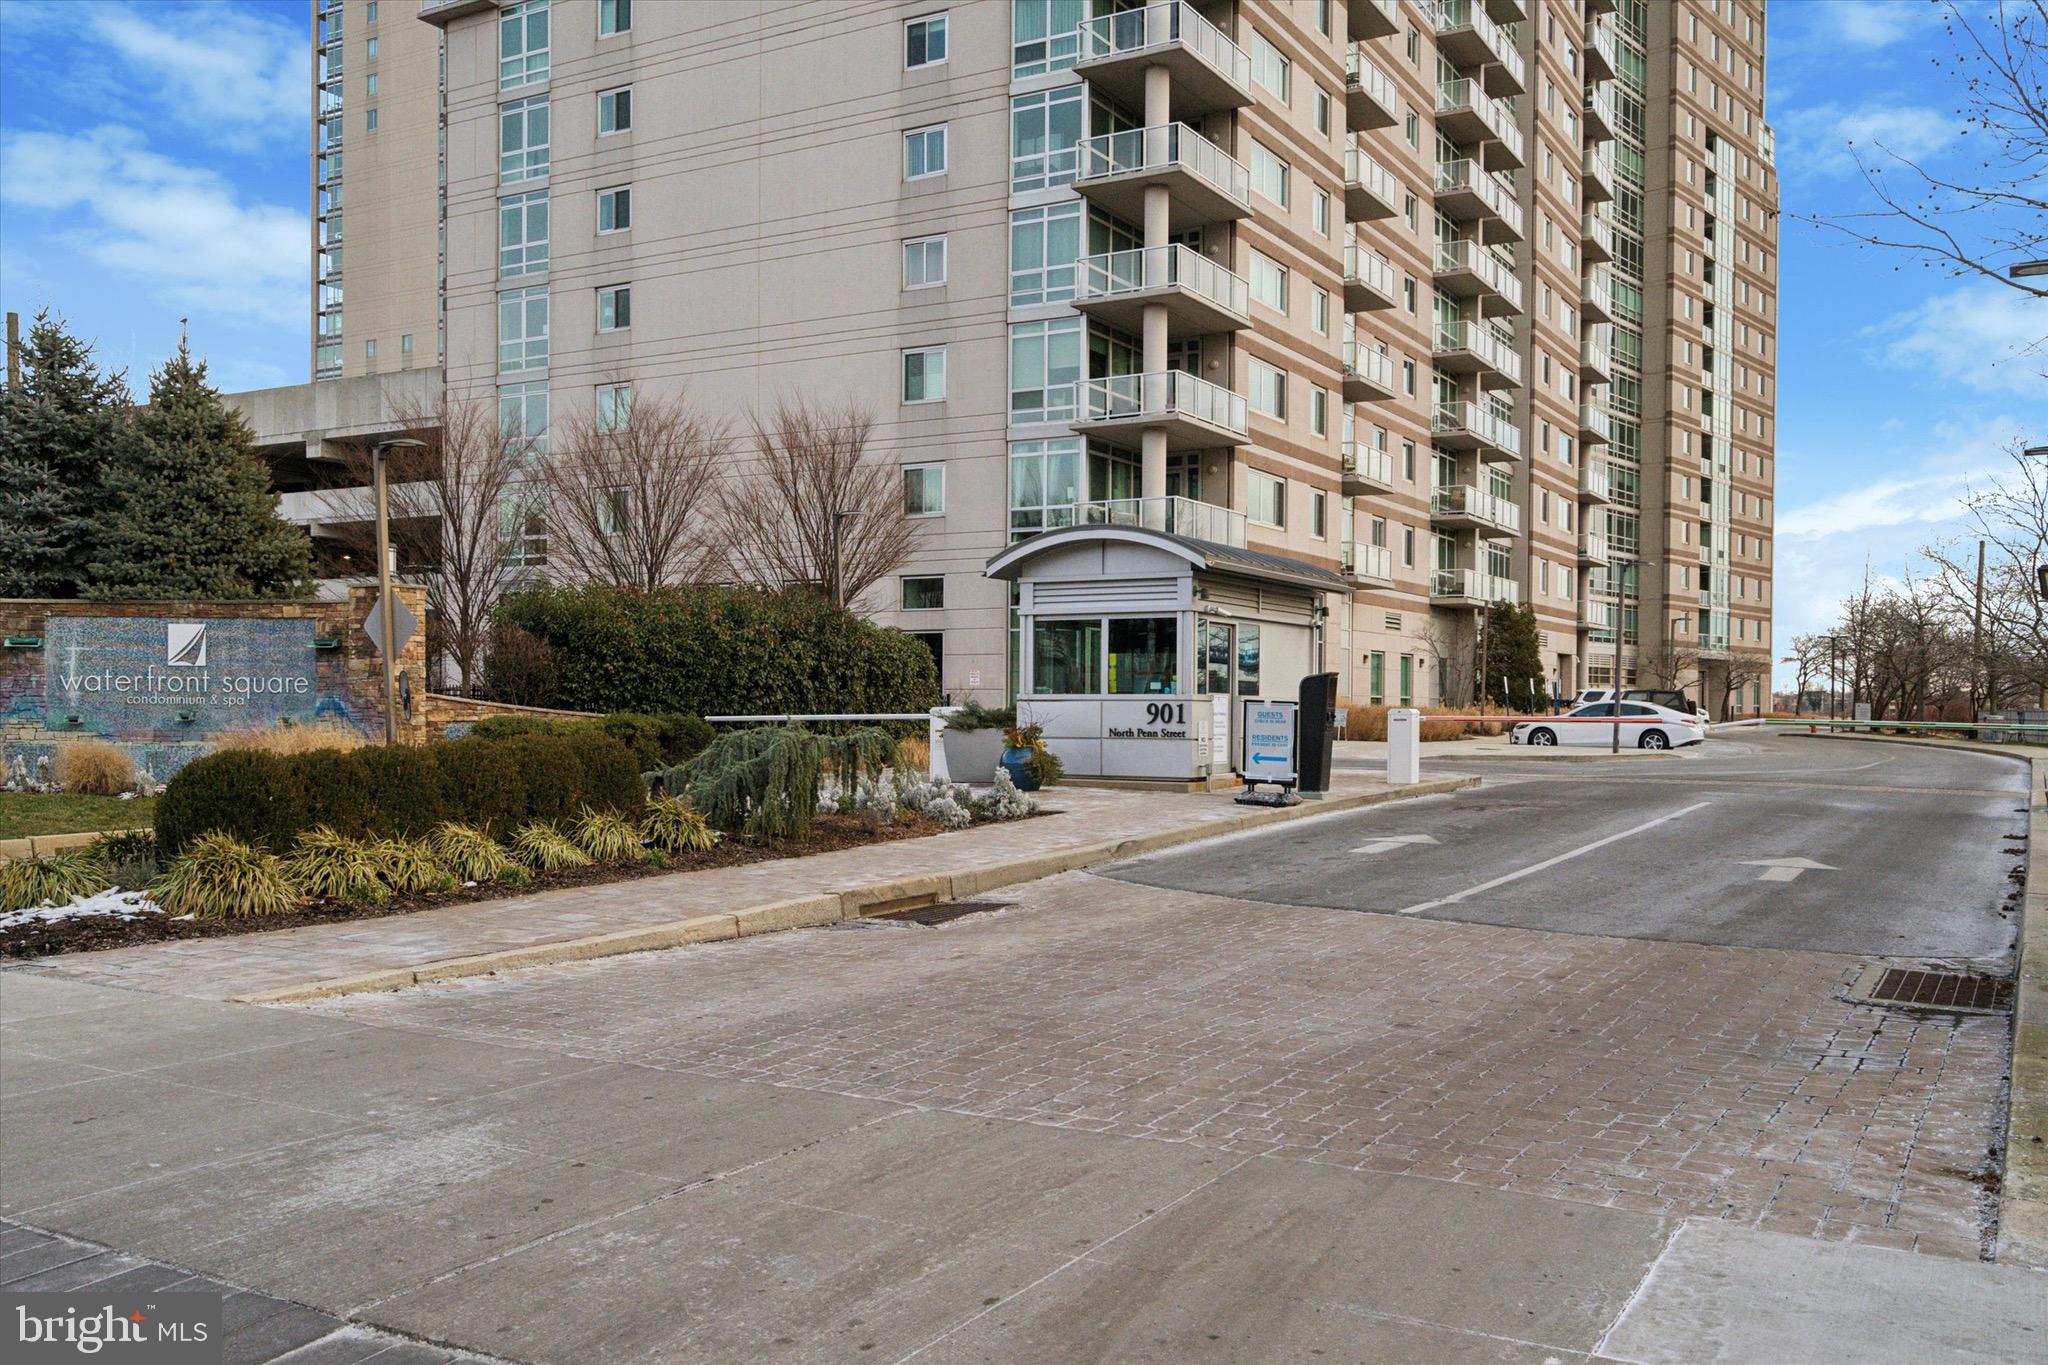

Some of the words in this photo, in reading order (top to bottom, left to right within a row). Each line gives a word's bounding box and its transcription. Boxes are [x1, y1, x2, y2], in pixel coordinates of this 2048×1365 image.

[60, 664, 210, 692] waterfront
[222, 676, 309, 699] square
[127, 691, 206, 705] condominium
[210, 694, 218, 705] &
[223, 696, 244, 707] spa
[1146, 703, 1186, 725] 901
[1257, 711, 1283, 719] GUESTS
[1109, 728, 1135, 738] North
[1137, 728, 1159, 738] Penn
[1161, 728, 1186, 738] Street
